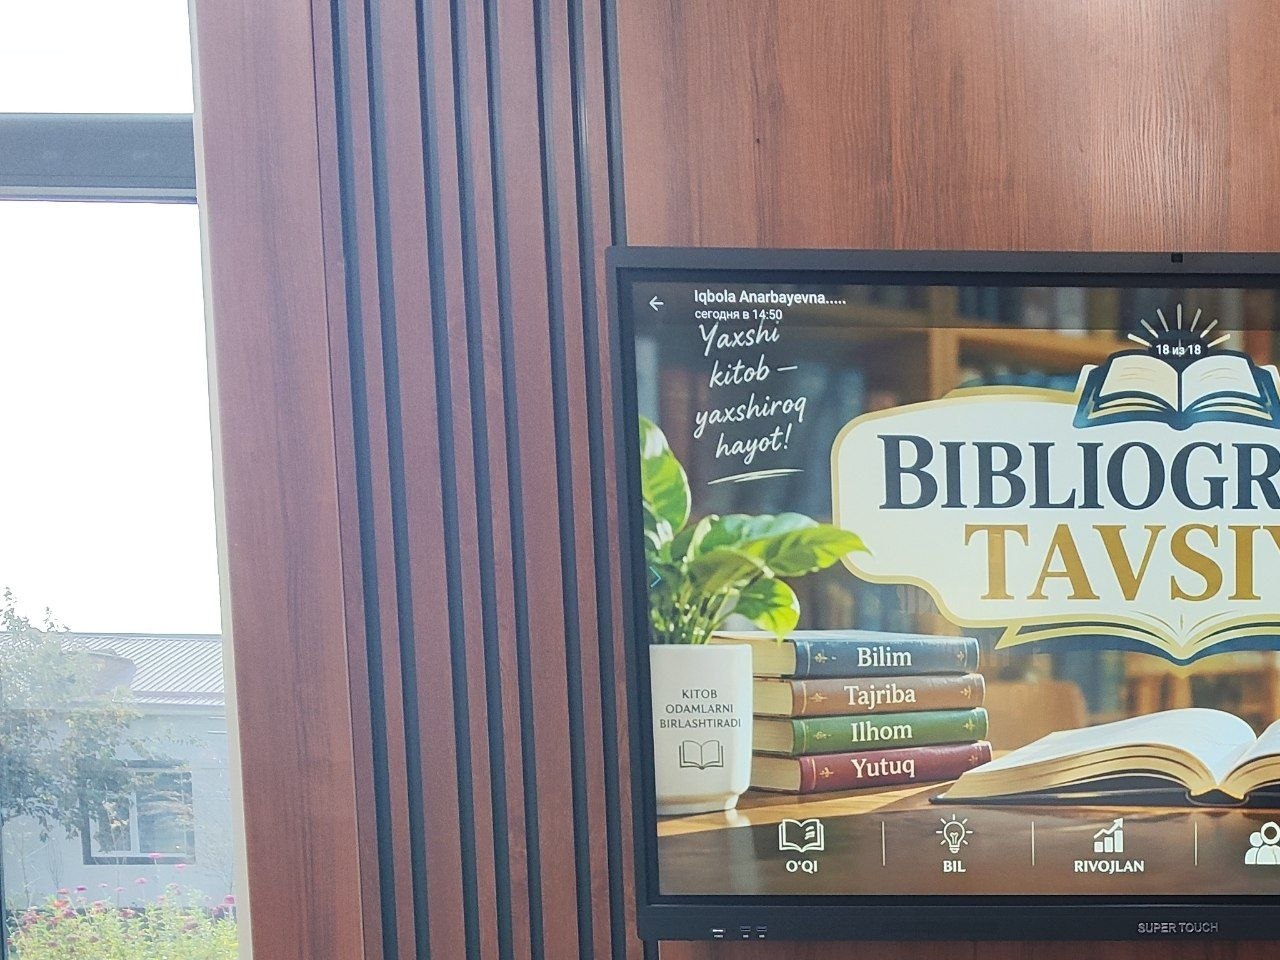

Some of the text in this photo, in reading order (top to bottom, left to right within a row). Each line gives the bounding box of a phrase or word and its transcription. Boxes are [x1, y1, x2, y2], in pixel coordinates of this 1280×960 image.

[694, 289, 736, 306] Iqbola
[694, 308, 783, 322] сегодня в 14:50
[698, 320, 780, 357] Yaxshi
[1156, 344, 1170, 355] 18
[1188, 344, 1202, 355] 18
[708, 360, 770, 389] kitob
[693, 394, 807, 440] yaxshiroq
[714, 424, 791, 466] hayot!
[856, 646, 913, 668] Bilim
[682, 688, 718, 699] KITOB
[844, 684, 917, 708] Tajriba
[665, 703, 733, 714] ODAMLARNI
[660, 717, 742, 729] BIRLASHTIRADI
[850, 721, 913, 743] Ilhom
[851, 757, 916, 780] Yutuq
[943, 860, 966, 873] BIL
[1074, 860, 1145, 874] RIVOJLAN
[1137, 921, 1219, 934] SUPER TOUCH
